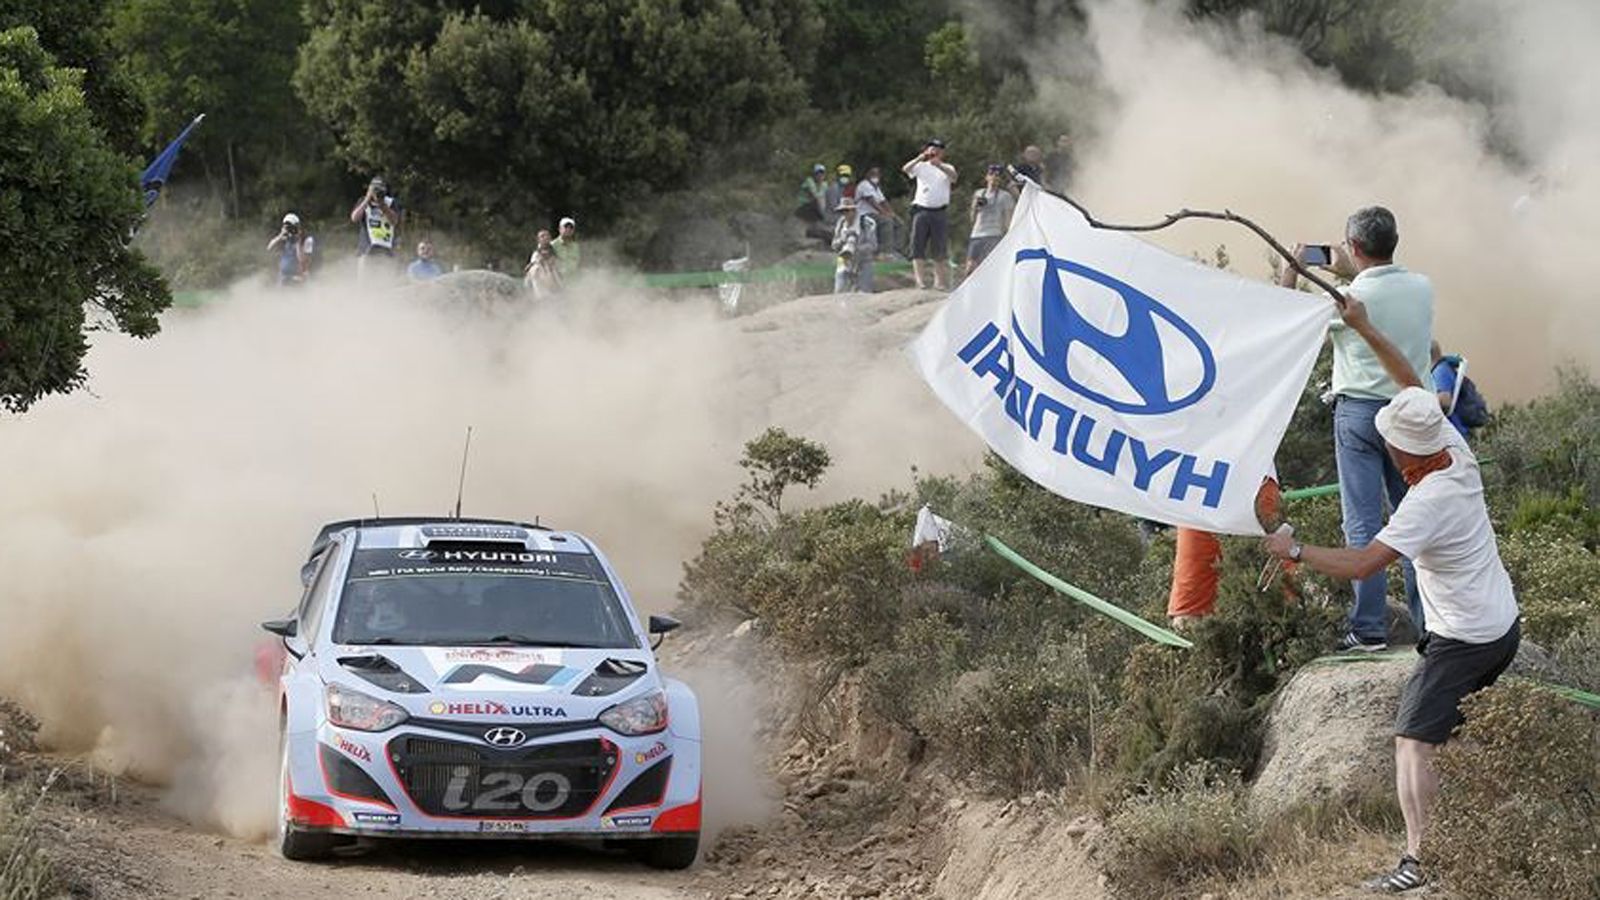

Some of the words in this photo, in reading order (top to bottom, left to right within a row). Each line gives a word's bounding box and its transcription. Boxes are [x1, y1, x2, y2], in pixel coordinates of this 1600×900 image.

[444, 551, 558, 563] HYUNDAI
[448, 700, 511, 715] HELIX
[511, 705, 568, 718] ULTRA
[340, 739, 372, 763] HELIX
[442, 765, 572, 812] i20
